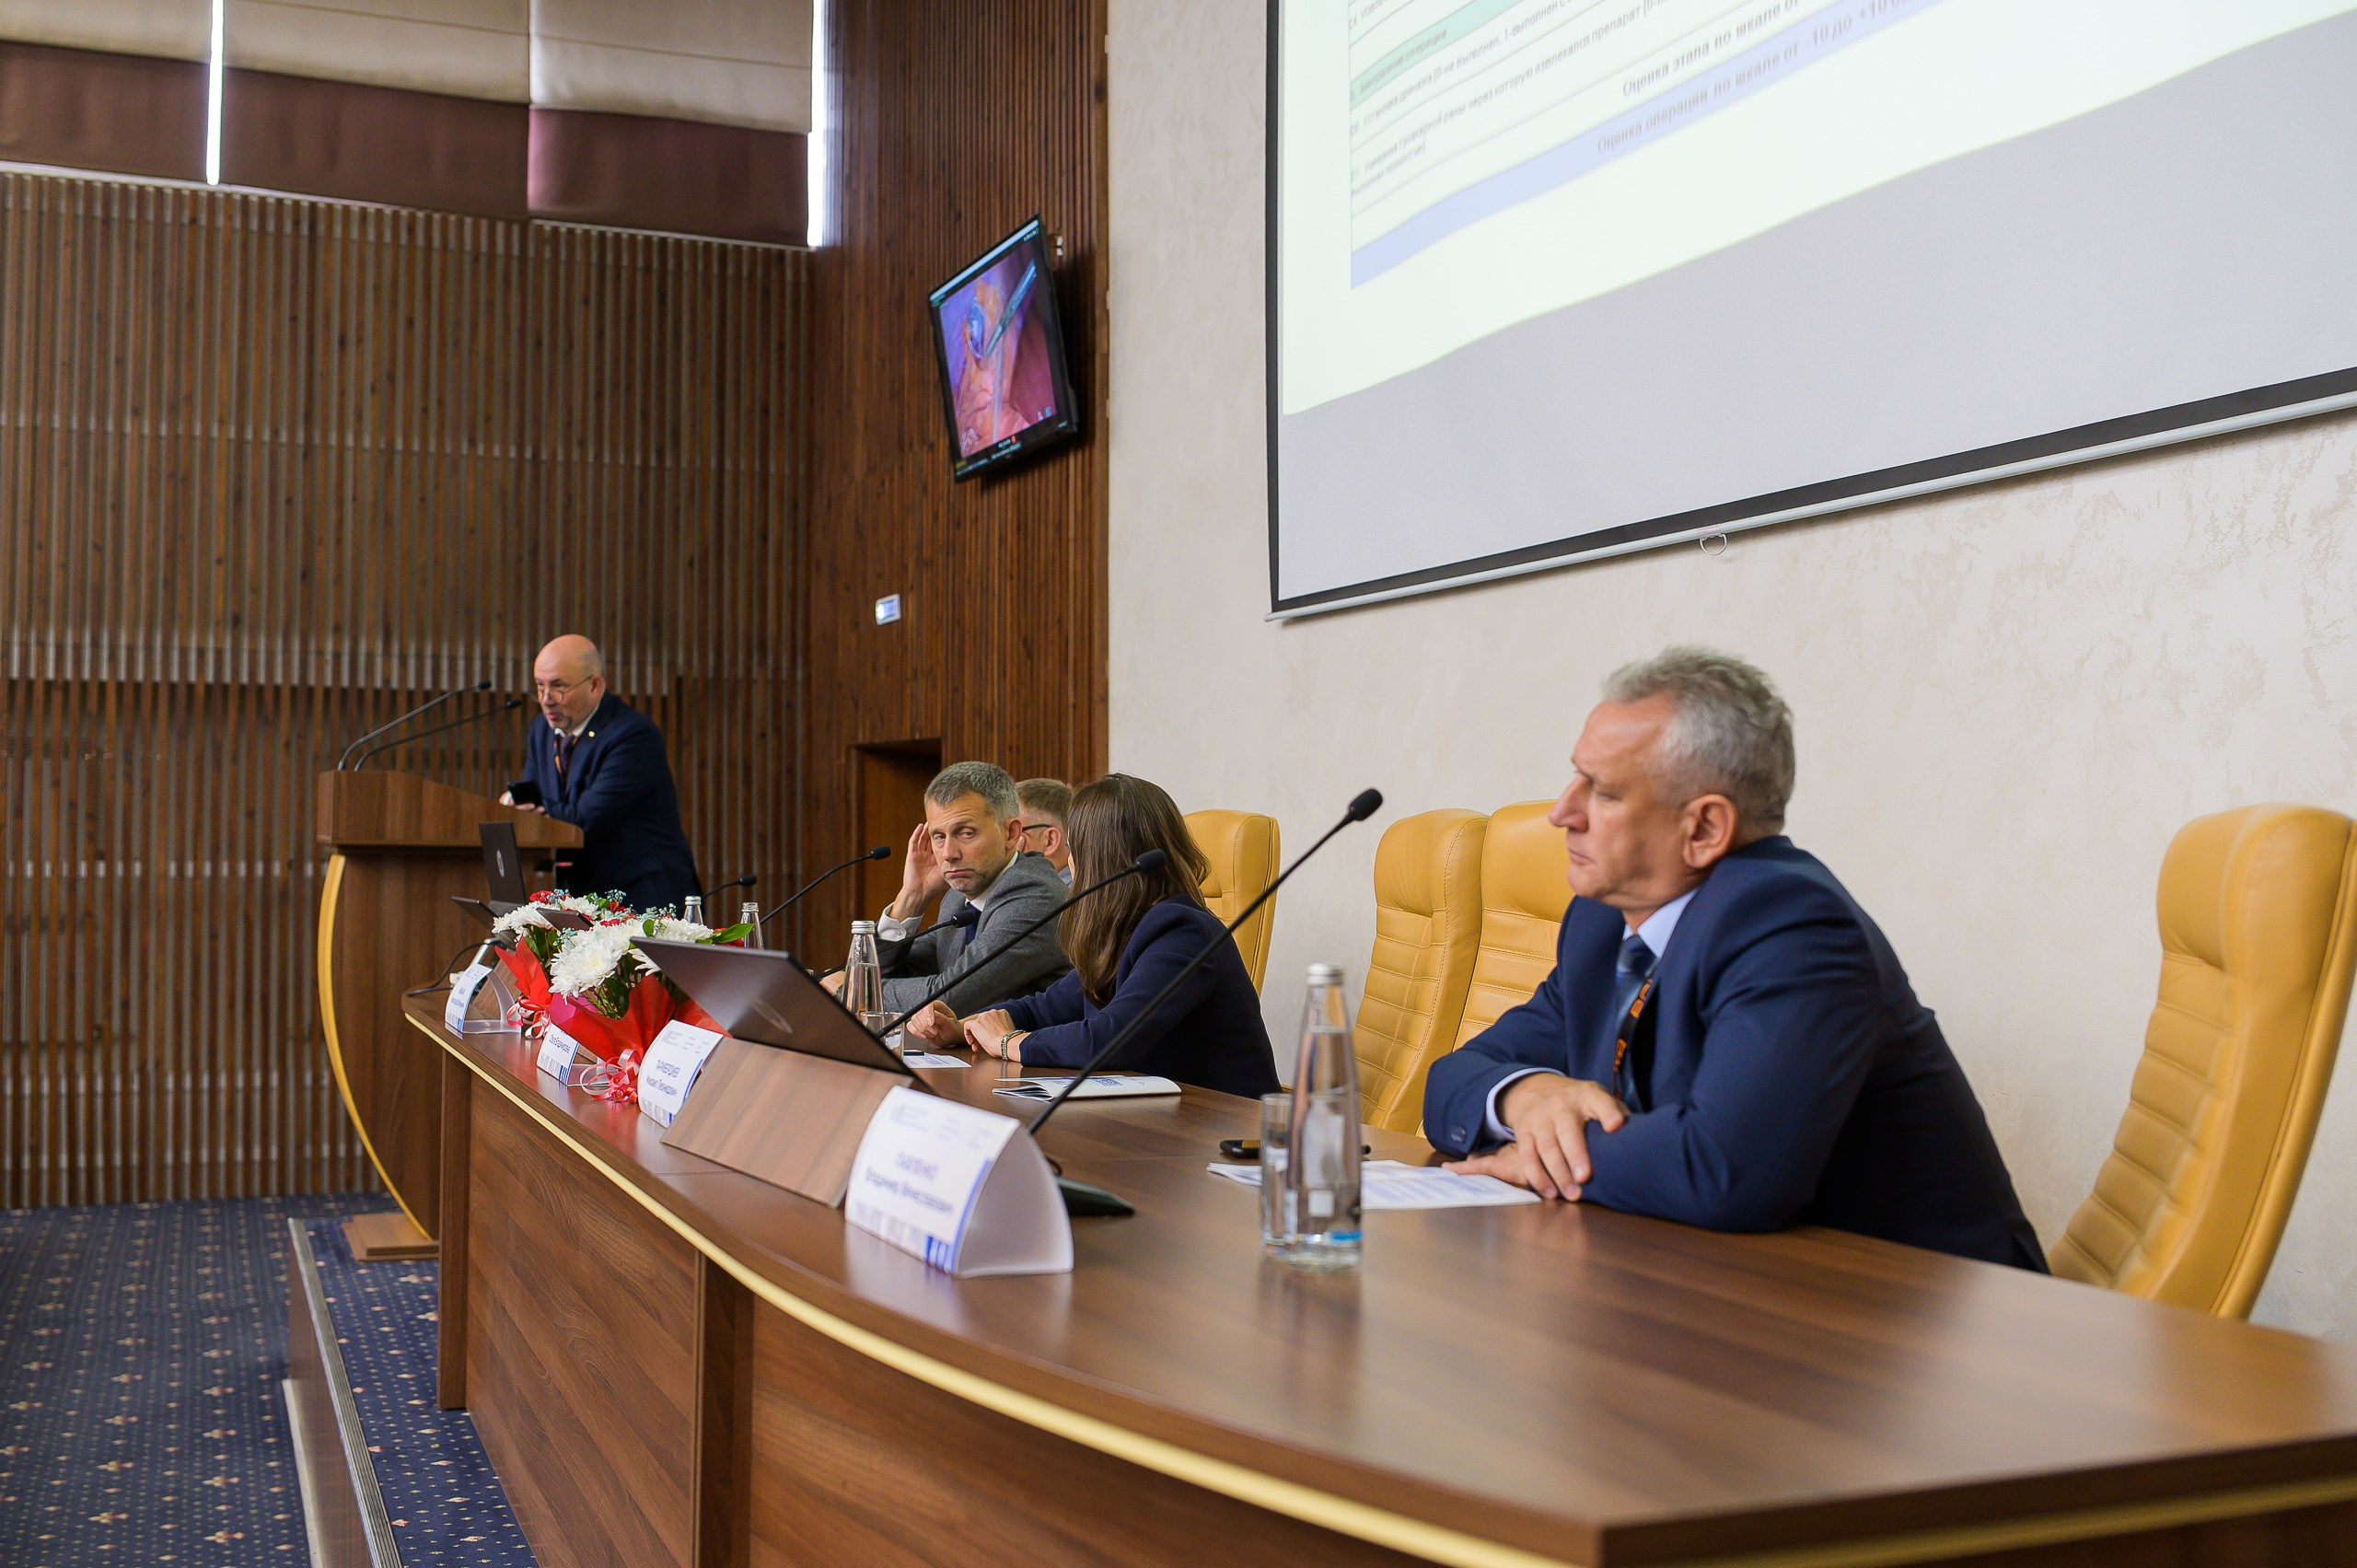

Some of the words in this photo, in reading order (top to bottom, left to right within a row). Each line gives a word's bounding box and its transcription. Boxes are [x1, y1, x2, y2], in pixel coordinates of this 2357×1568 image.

[1405, 29, 1447, 62] операции
[1494, 67, 1533, 98] которую
[1534, 36, 1590, 75] извлекался
[1591, 6, 1642, 44] препарат
[1597, 122, 1643, 155] Оценка
[1644, 86, 1708, 134] операции
[1713, 79, 1732, 99] по
[1735, 54, 1781, 89] шкале
[1782, 41, 1800, 63] от
[1830, 16, 1853, 43] до
[1622, 63, 1670, 98] Оценка
[1672, 42, 1711, 73] этапа
[1713, 29, 1732, 51] по
[1736, 6, 1782, 41] шкале
